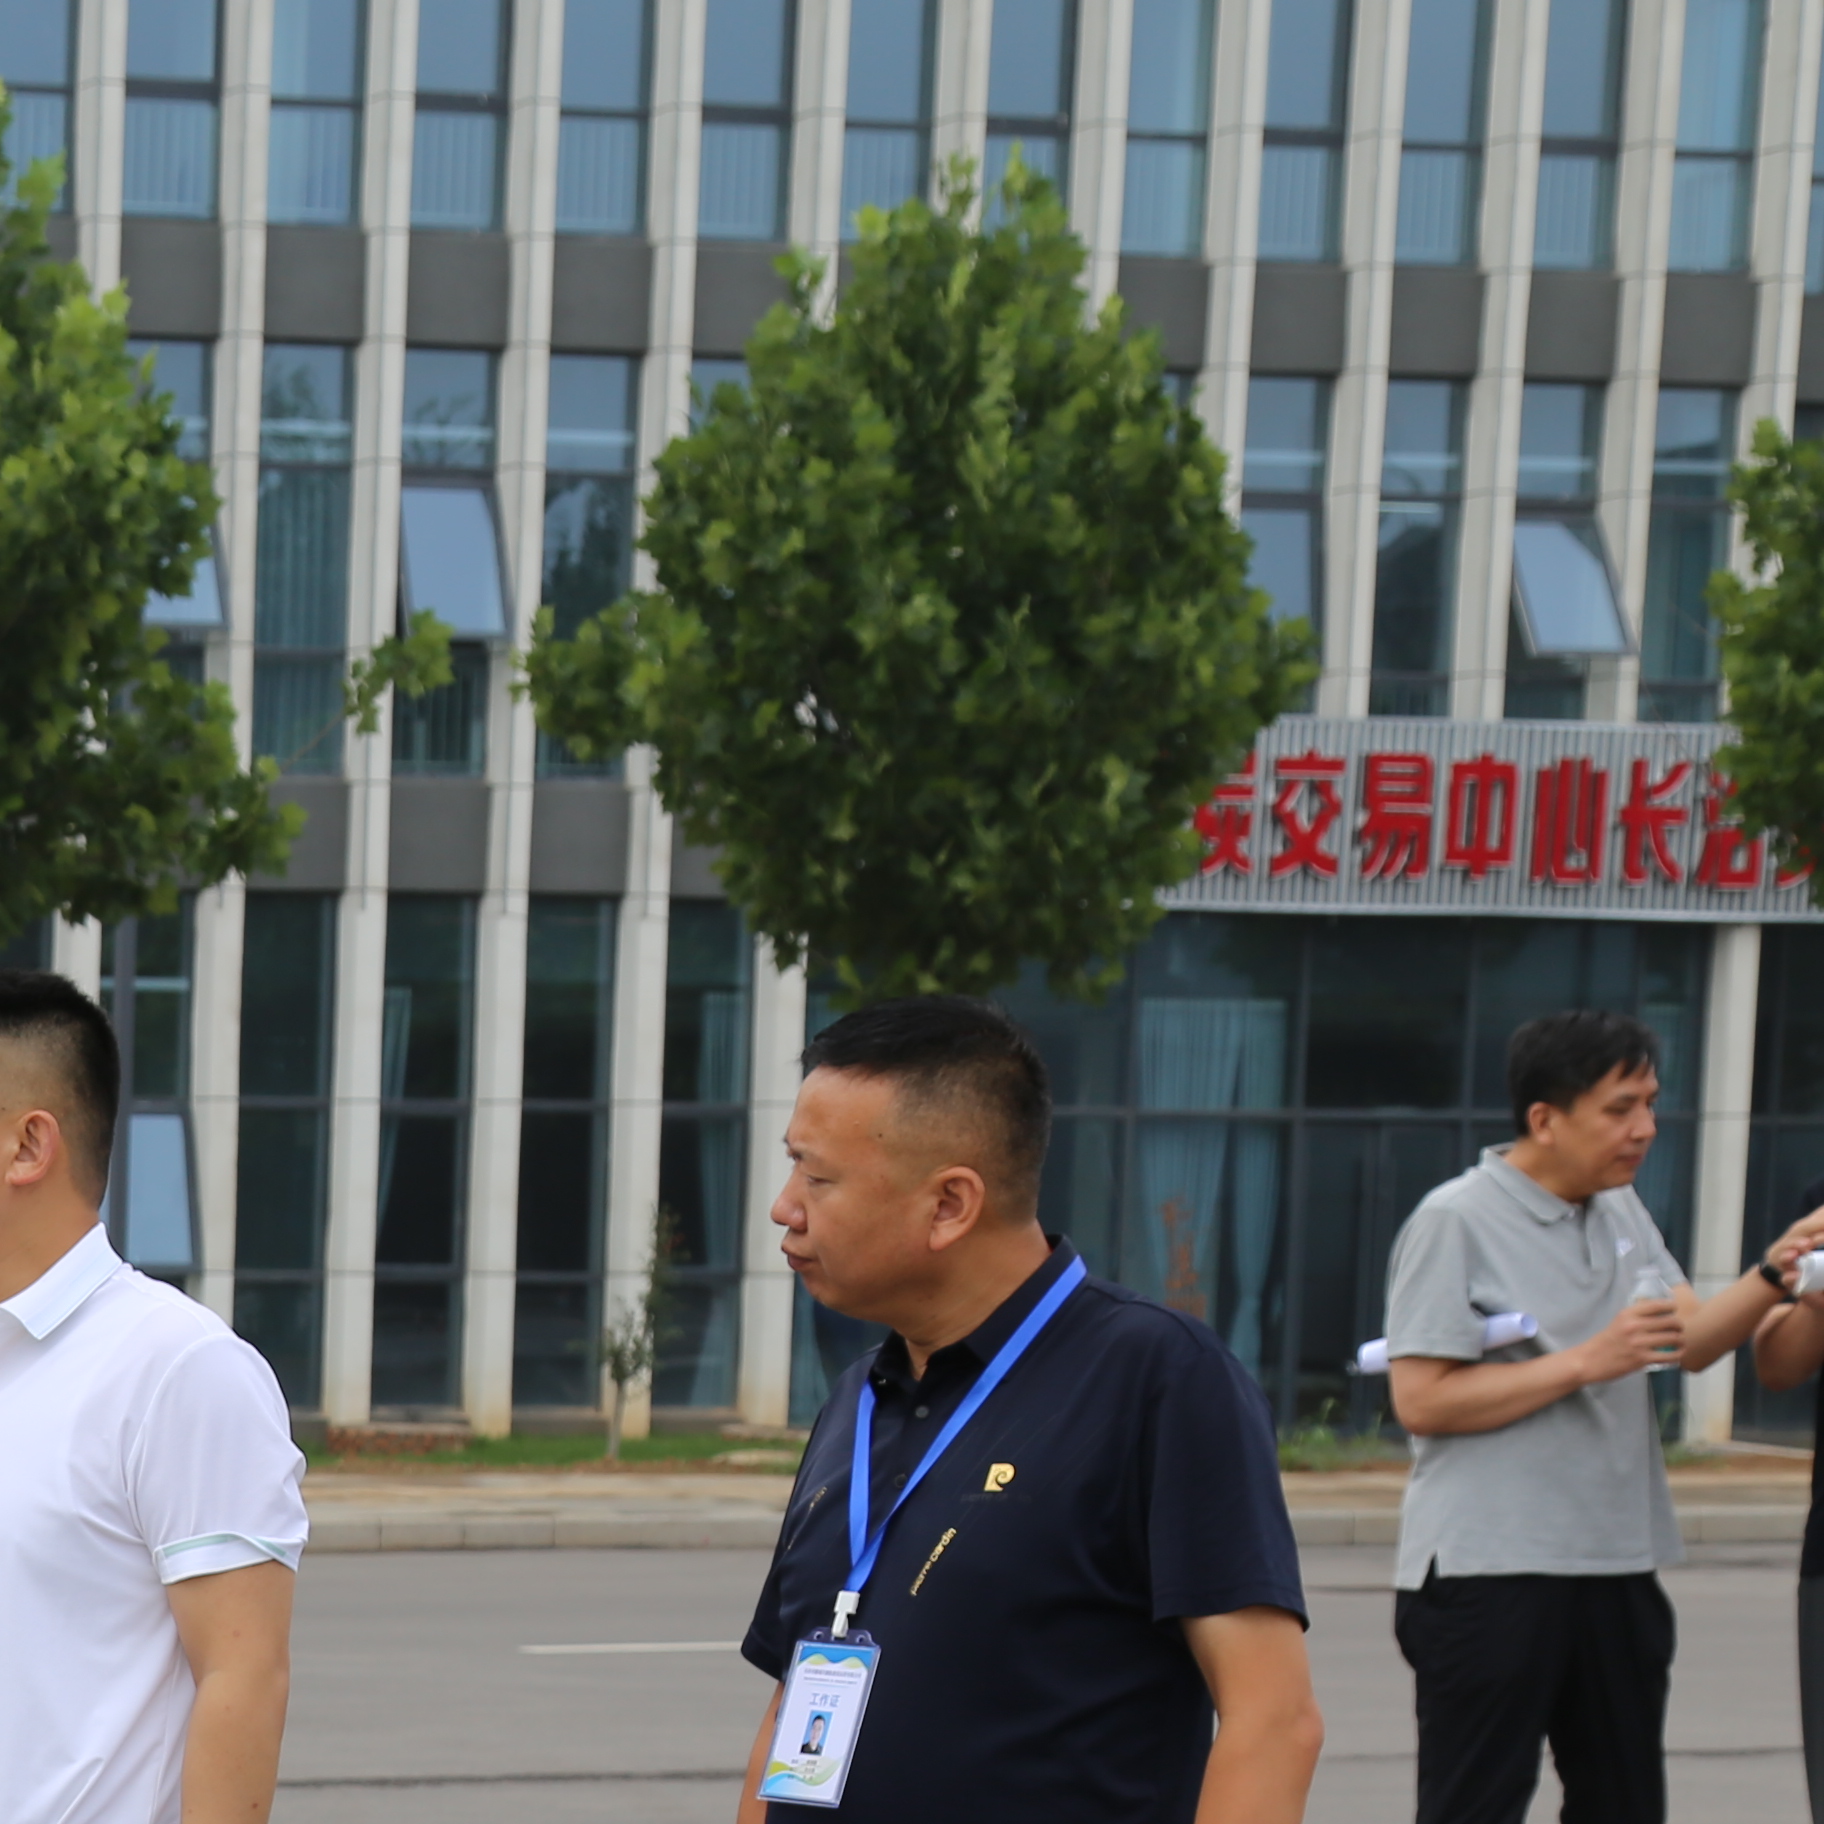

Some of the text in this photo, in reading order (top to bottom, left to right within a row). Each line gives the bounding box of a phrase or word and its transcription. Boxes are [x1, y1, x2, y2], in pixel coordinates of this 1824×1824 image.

[930, 1527, 957, 1562] cardin
[809, 1692, 841, 1708] 工作证
